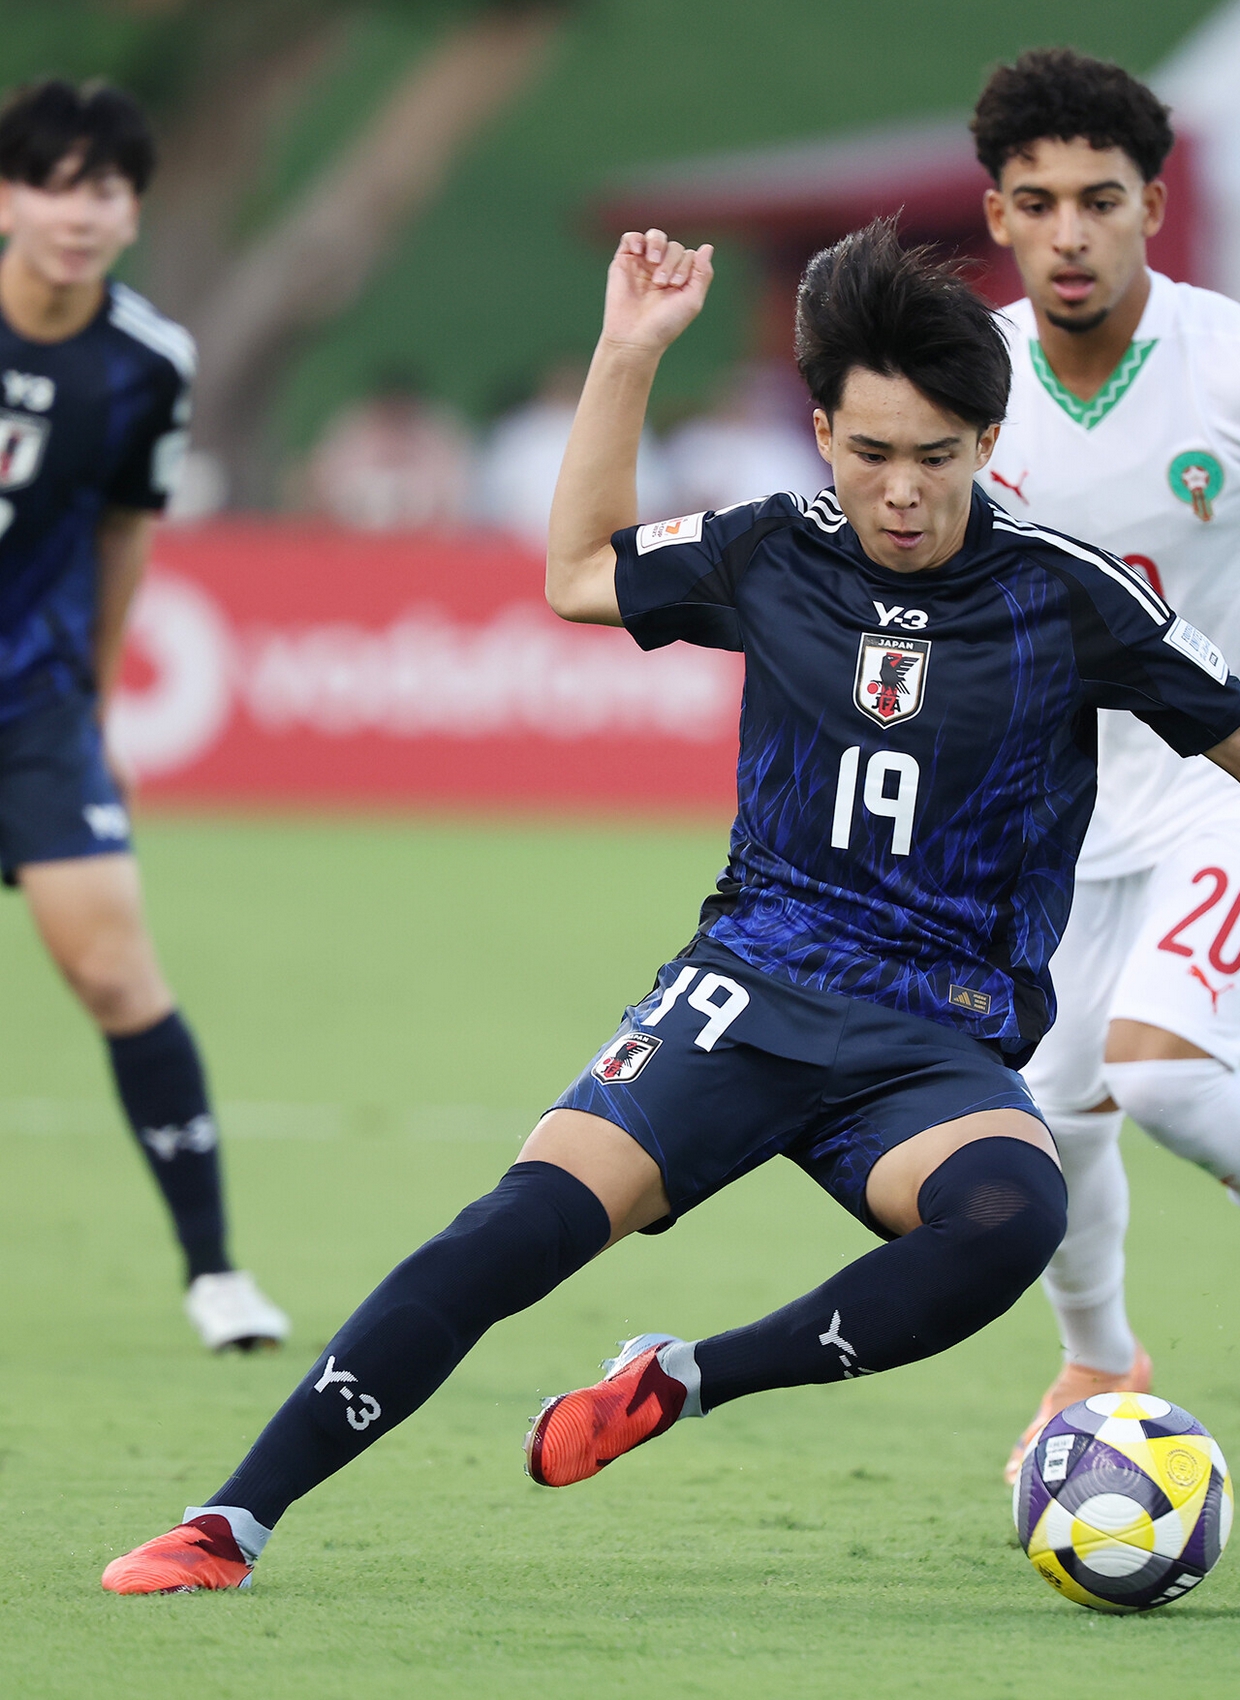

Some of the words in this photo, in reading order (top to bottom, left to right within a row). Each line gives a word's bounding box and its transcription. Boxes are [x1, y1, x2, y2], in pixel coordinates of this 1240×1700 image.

[872, 600, 929, 630] Y-3
[878, 639, 914, 650] JAPAN
[871, 696, 902, 713] JFA
[831, 745, 920, 856] 19
[641, 965, 751, 1053] 19
[313, 1354, 382, 1431] Y-3
